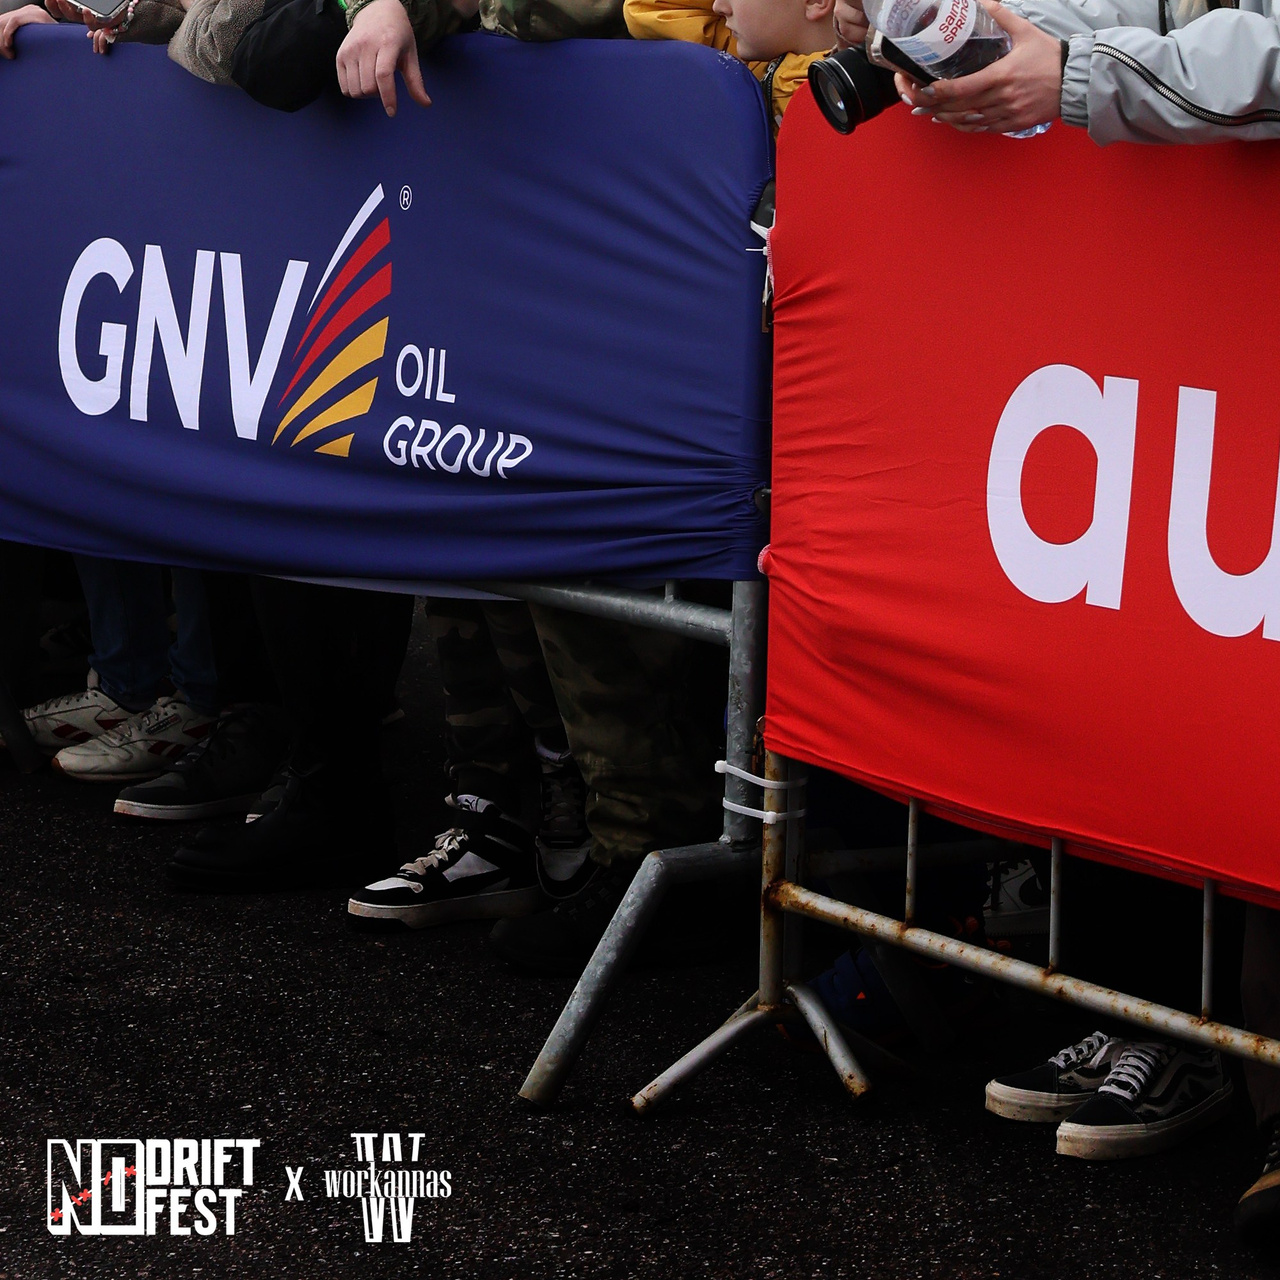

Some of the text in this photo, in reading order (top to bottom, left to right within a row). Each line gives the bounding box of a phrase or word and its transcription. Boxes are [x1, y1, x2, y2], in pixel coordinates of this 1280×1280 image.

[58, 237, 310, 441] GNV
[395, 343, 456, 404] OIL
[382, 415, 534, 479] GROUP
